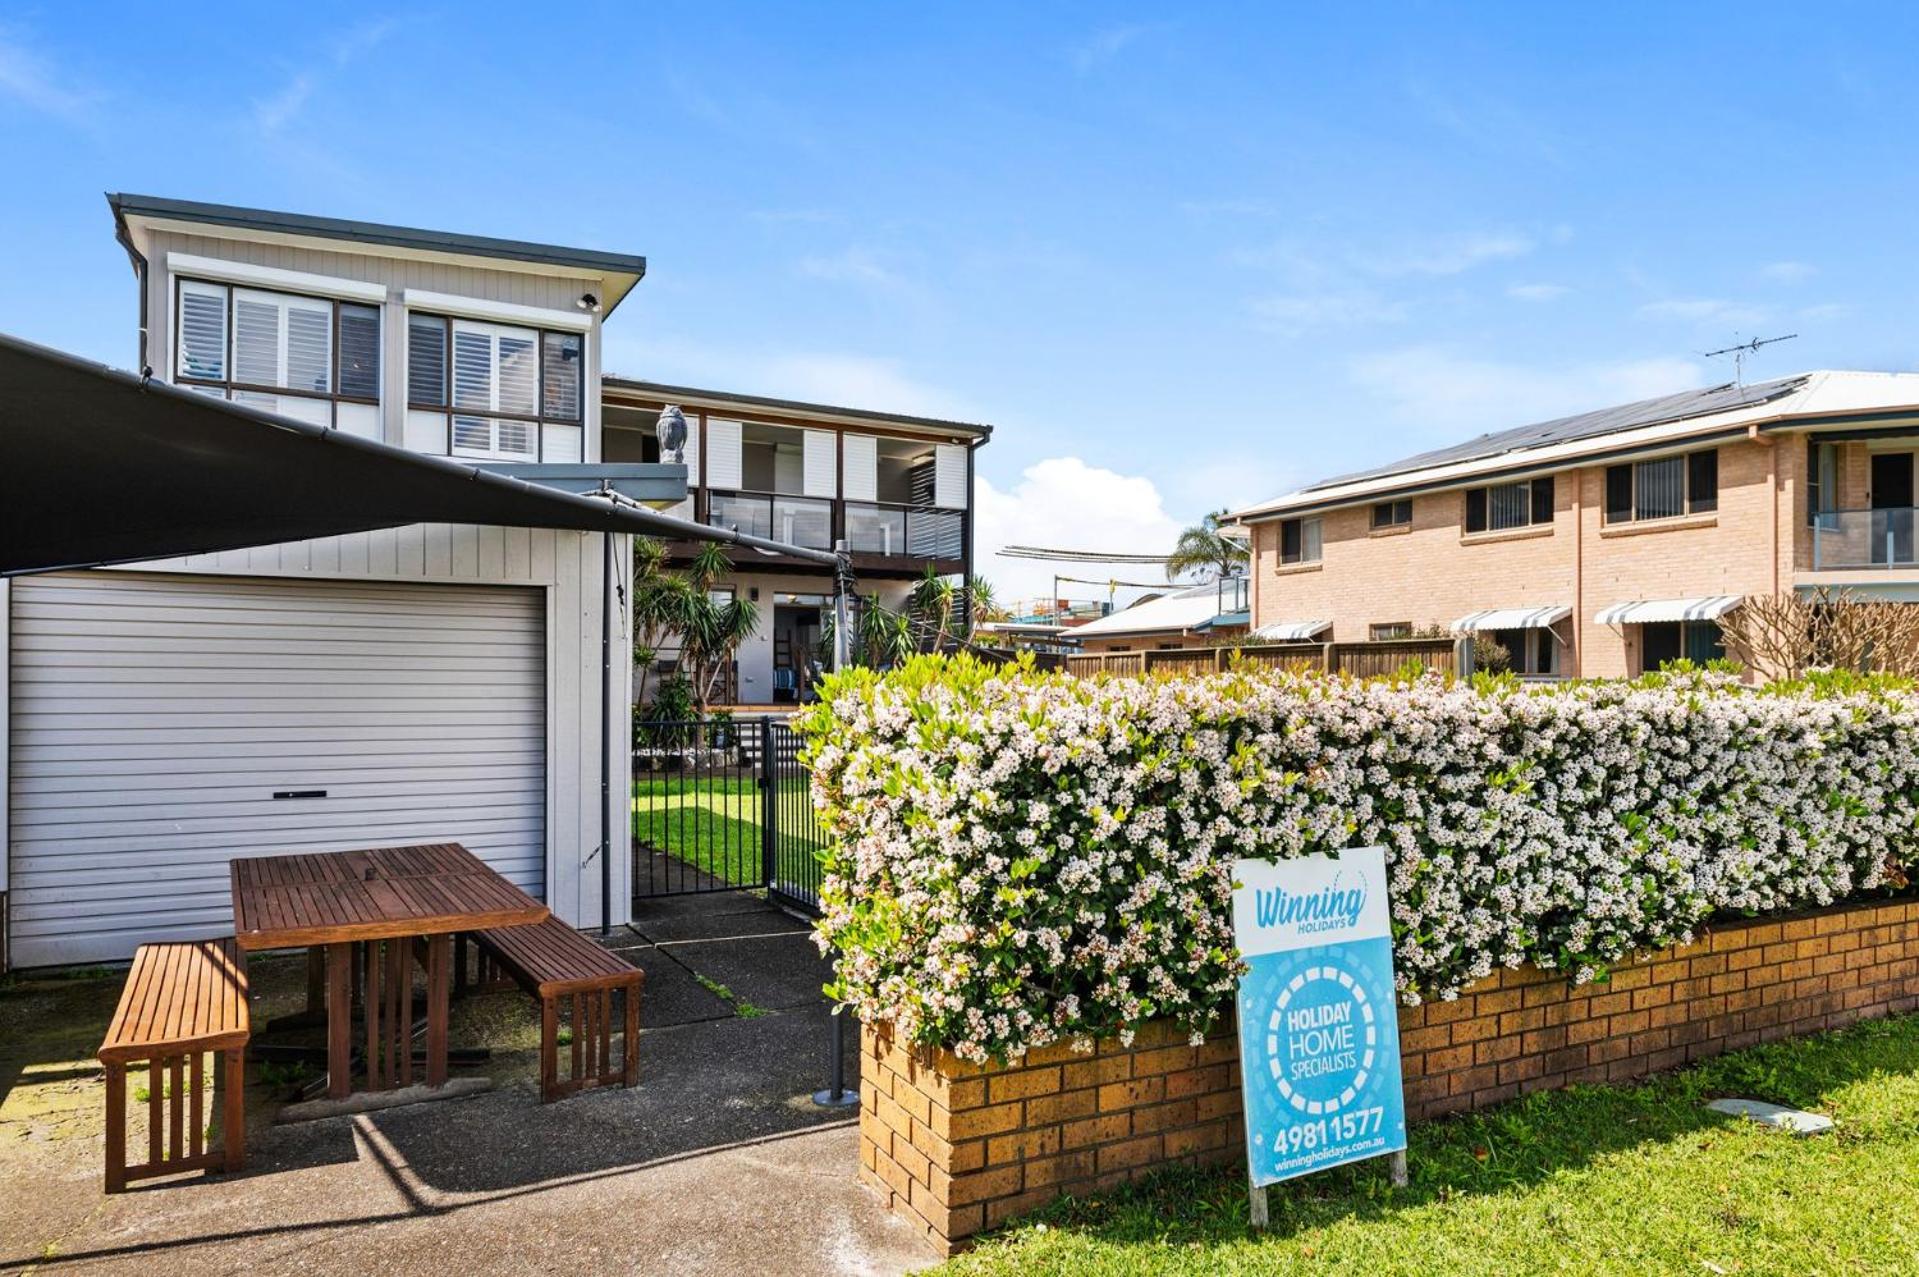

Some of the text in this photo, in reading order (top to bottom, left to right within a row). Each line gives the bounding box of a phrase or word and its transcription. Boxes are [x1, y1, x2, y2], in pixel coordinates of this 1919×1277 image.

[1256, 886, 1362, 928] Winning
[1298, 918, 1346, 934] HOLIDAYS
[1287, 1001, 1352, 1032] HOLIDAY
[1289, 1024, 1355, 1060] HOME
[1291, 1050, 1357, 1081] SPECIALISTS
[1274, 1136, 1386, 1171] winningholidays.com.au
